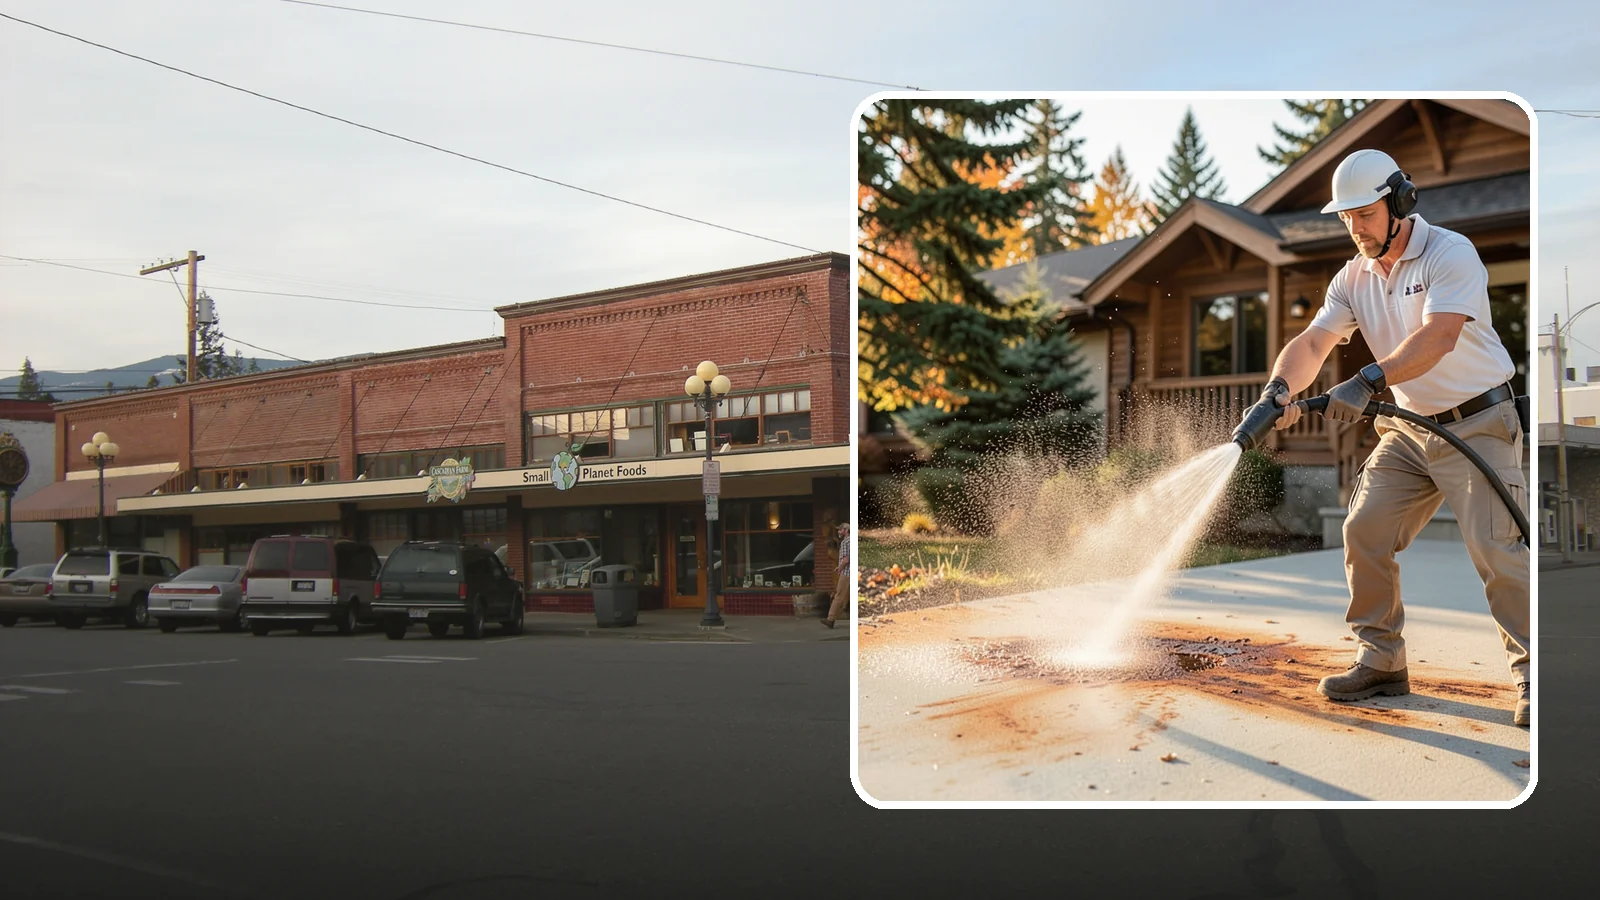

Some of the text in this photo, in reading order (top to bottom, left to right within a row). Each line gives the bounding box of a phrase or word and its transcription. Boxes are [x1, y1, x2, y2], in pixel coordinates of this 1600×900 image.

[523, 464, 647, 483] Small Planet Foods
